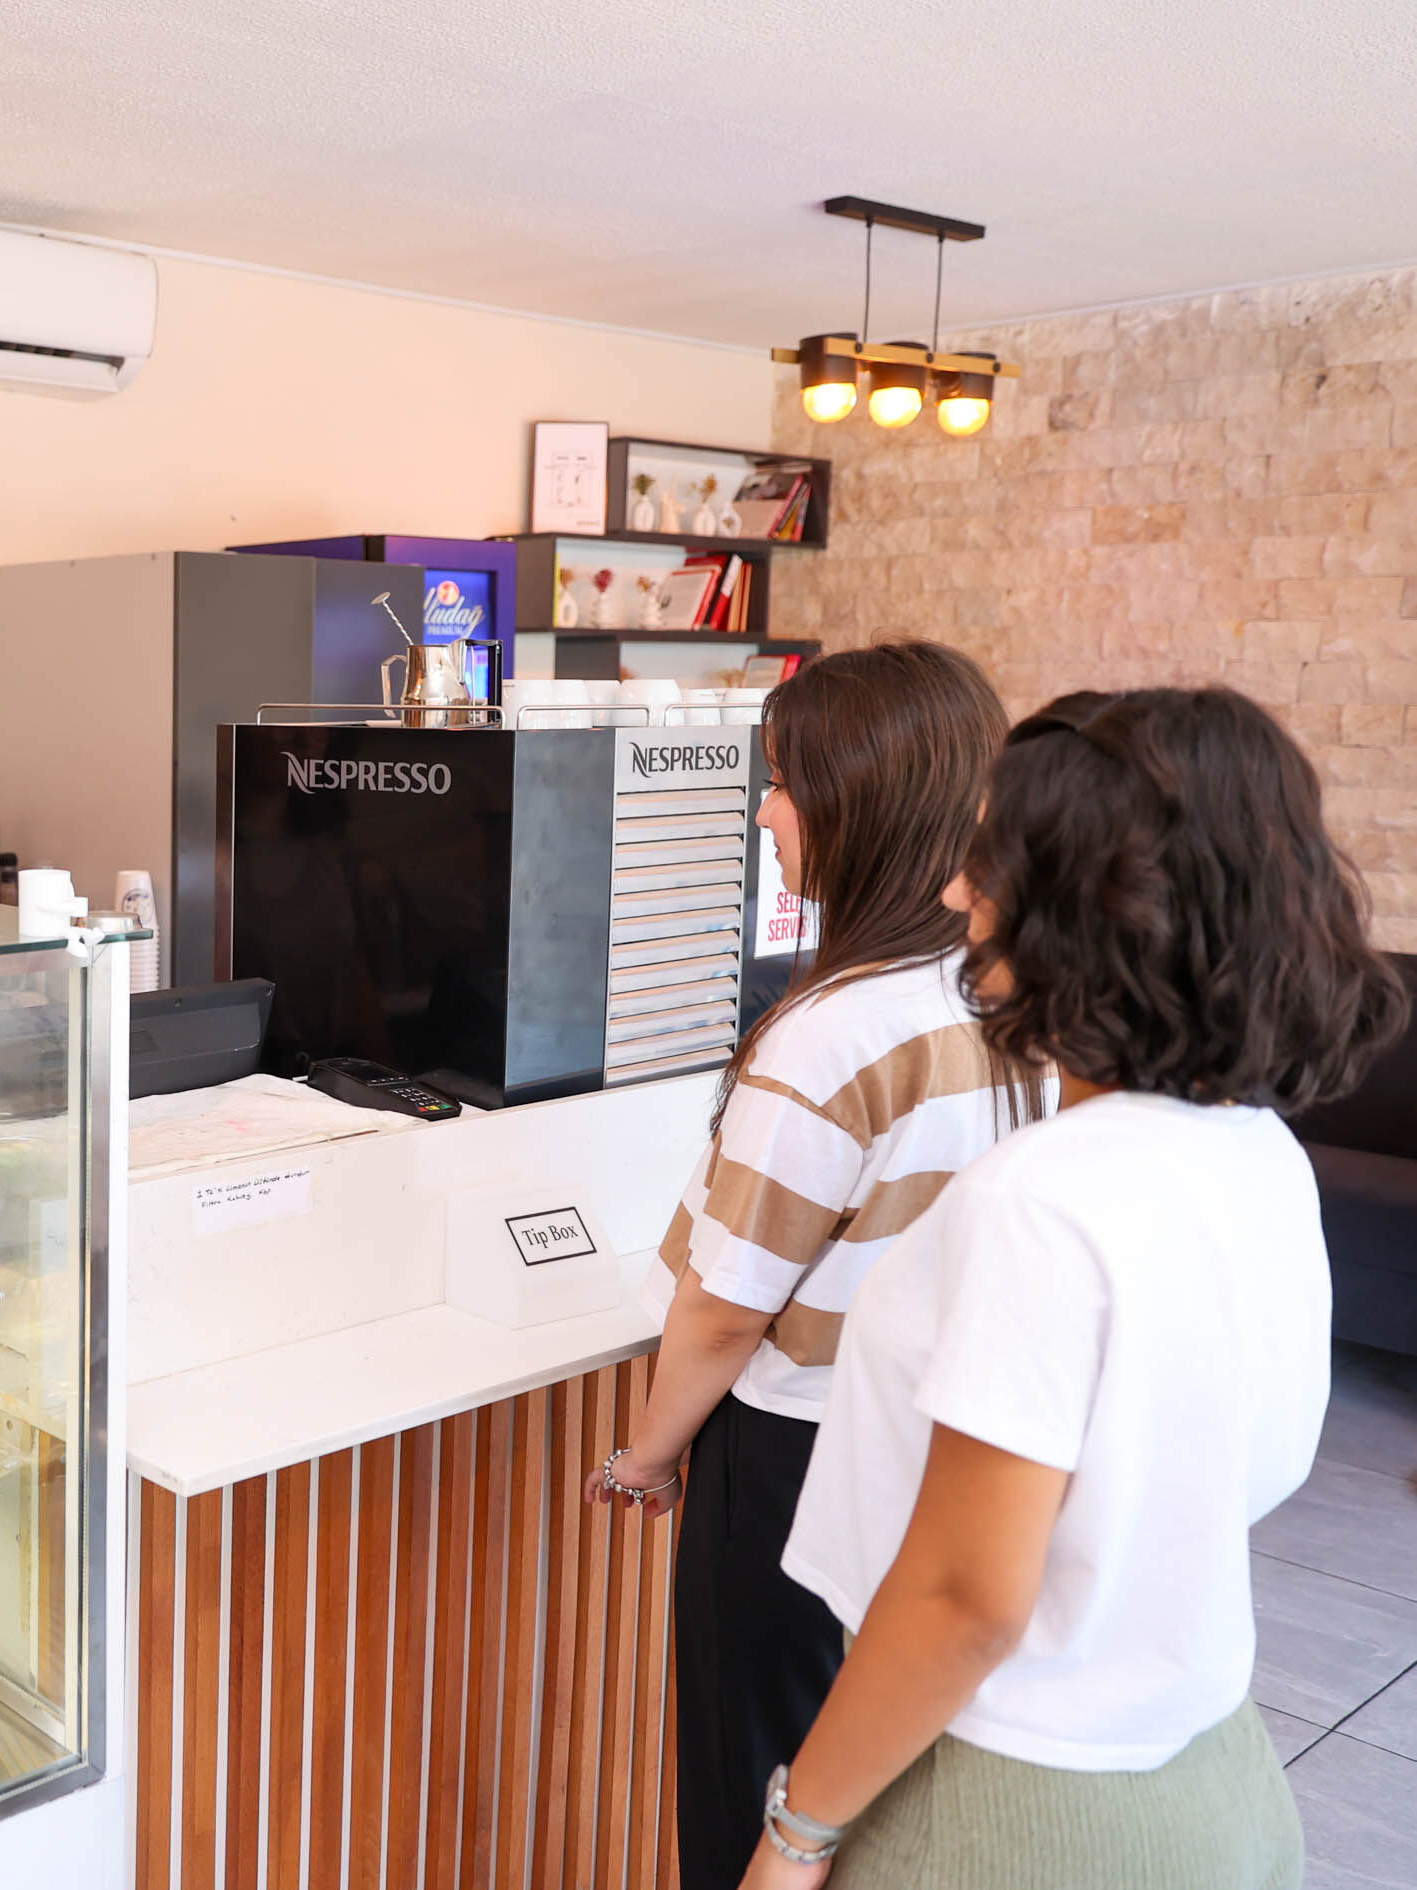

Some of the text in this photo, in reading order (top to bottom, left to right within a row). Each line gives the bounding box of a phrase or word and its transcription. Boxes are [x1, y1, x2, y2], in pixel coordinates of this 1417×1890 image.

[279, 751, 452, 795] NESPRESSO
[628, 741, 740, 779] NESPRESSO
[777, 891, 802, 915] SELF
[521, 1225, 579, 1249] Tip Box
